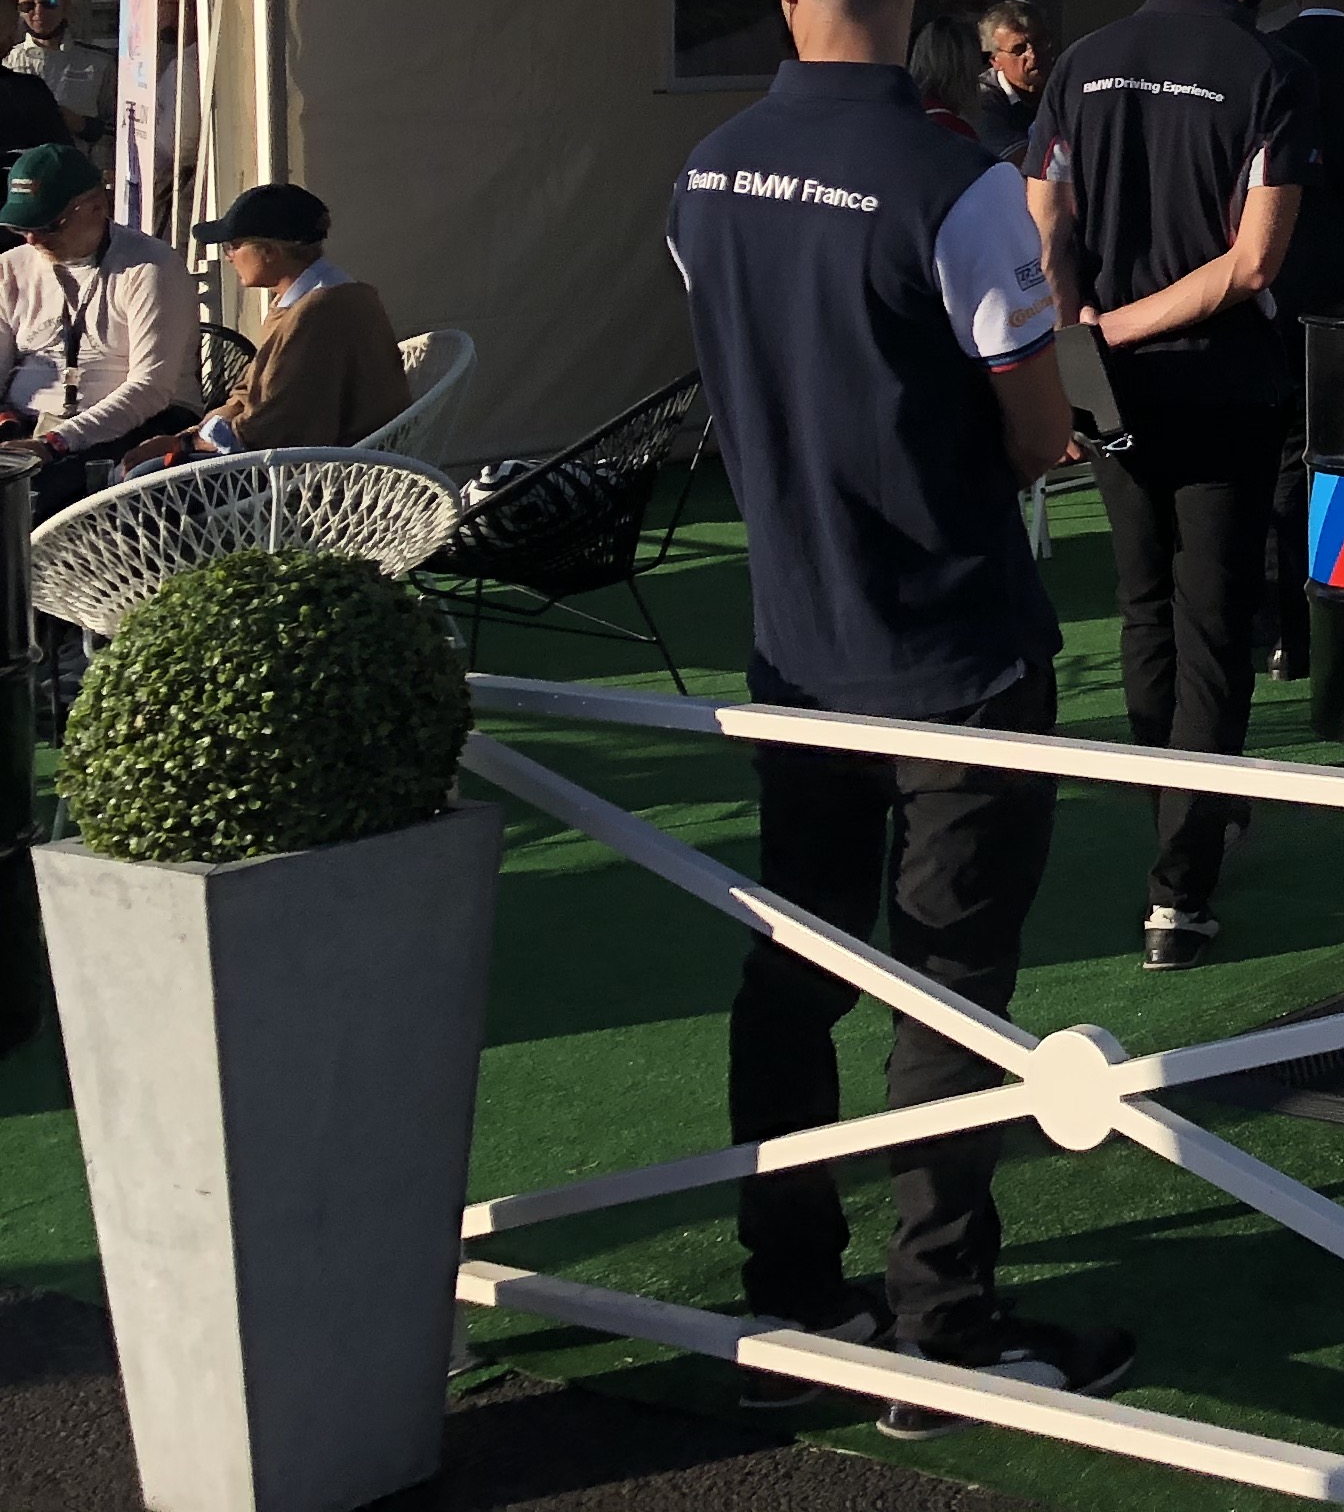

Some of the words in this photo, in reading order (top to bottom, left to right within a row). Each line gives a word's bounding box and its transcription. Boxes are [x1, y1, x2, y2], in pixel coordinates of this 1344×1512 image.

[1083, 78, 1114, 93] BMW
[1114, 77, 1160, 94] Driving
[1163, 80, 1225, 102] Experience
[687, 169, 728, 192] Team
[733, 170, 799, 201] BMW
[801, 178, 879, 213] France
